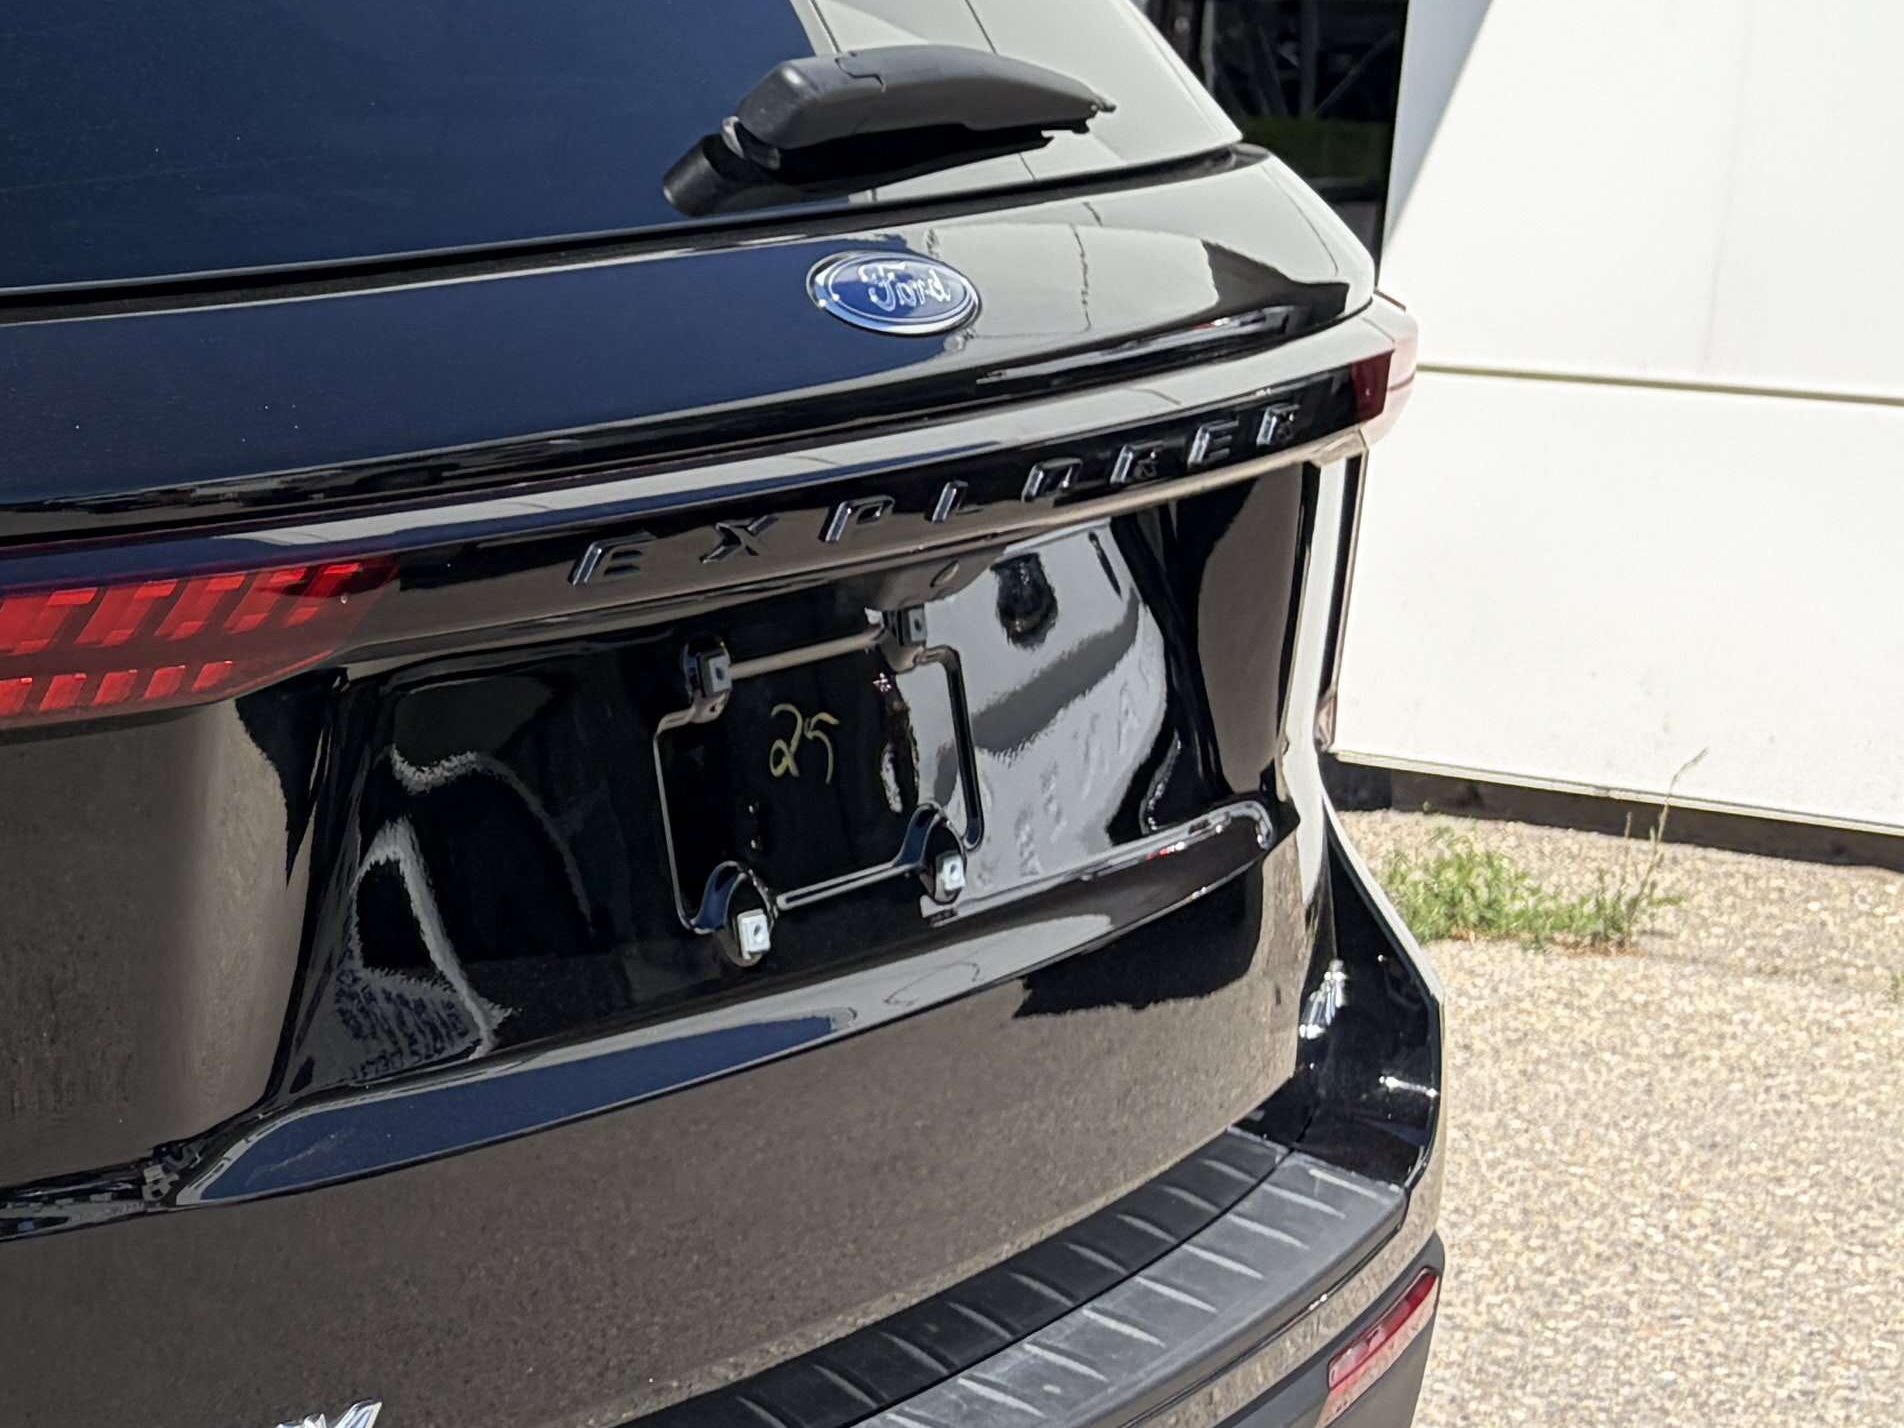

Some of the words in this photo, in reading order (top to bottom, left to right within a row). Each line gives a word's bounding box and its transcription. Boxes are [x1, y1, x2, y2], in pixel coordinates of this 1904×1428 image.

[857, 260, 952, 313] Ford
[568, 401, 1301, 588] EXPLORER
[769, 703, 840, 784] 25
